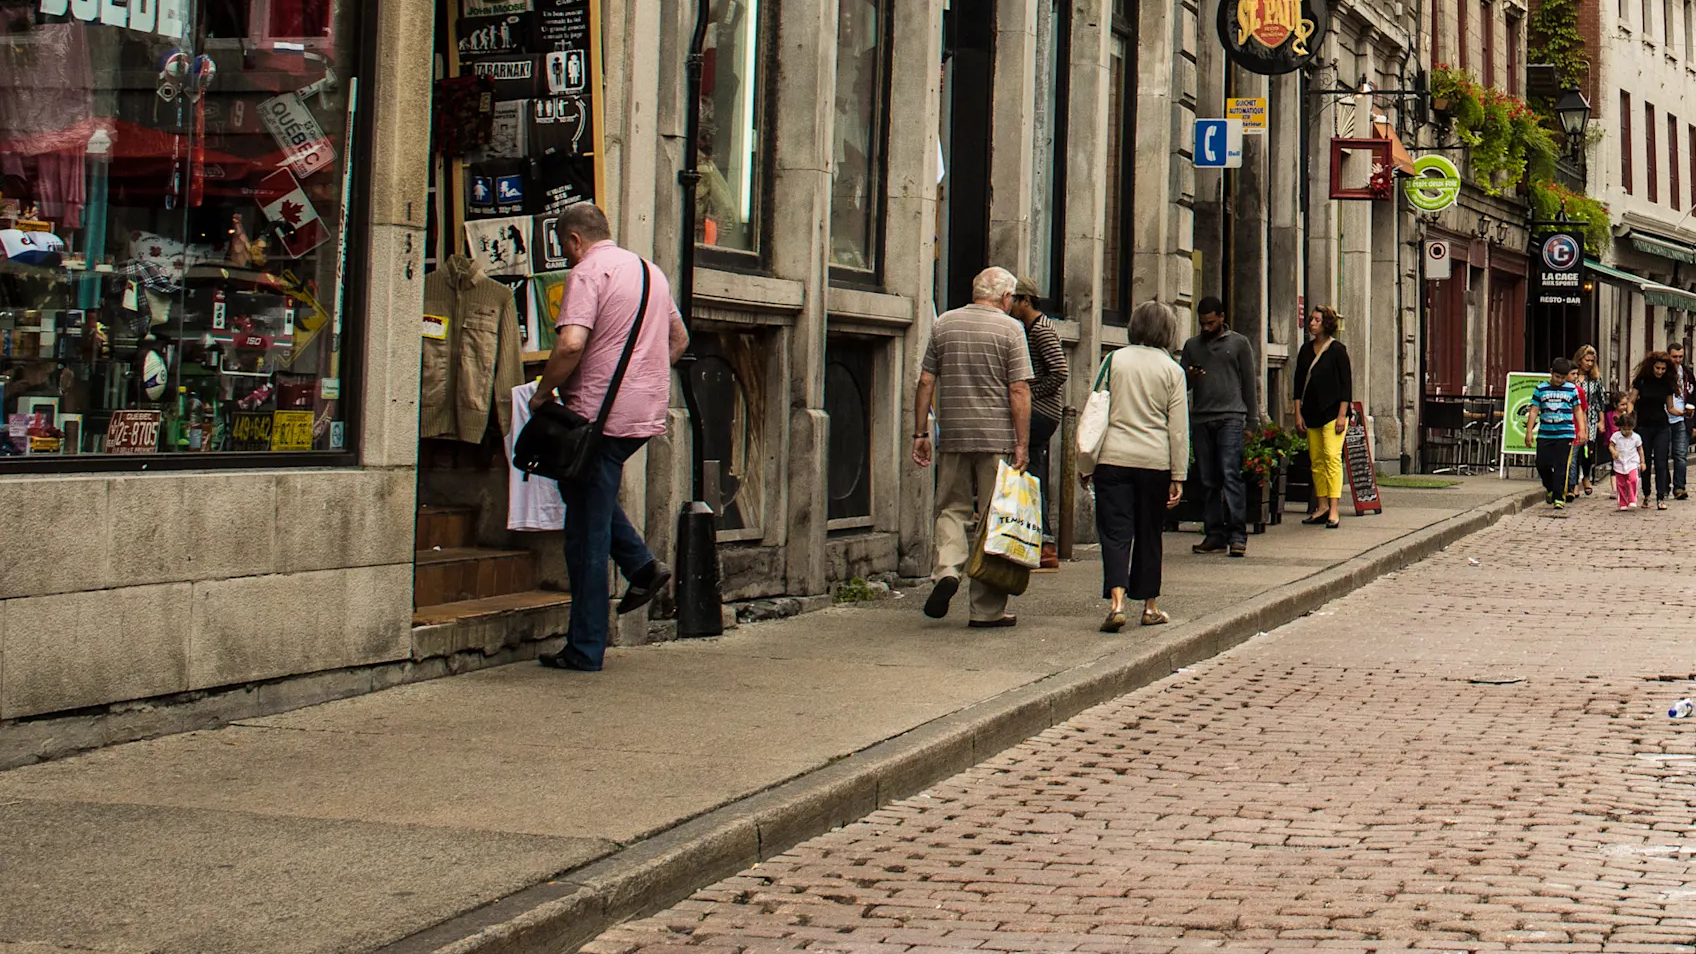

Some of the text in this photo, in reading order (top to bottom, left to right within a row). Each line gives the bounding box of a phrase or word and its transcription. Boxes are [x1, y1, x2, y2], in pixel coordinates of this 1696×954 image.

[467, 3, 526, 16] JOHN MOOSE
[1228, 107, 1265, 115] AUTOMATIQUE
[545, 260, 569, 269] GAME
[1541, 272, 1580, 280] LA CAGE
[1540, 296, 1581, 305] RESTO BAR
